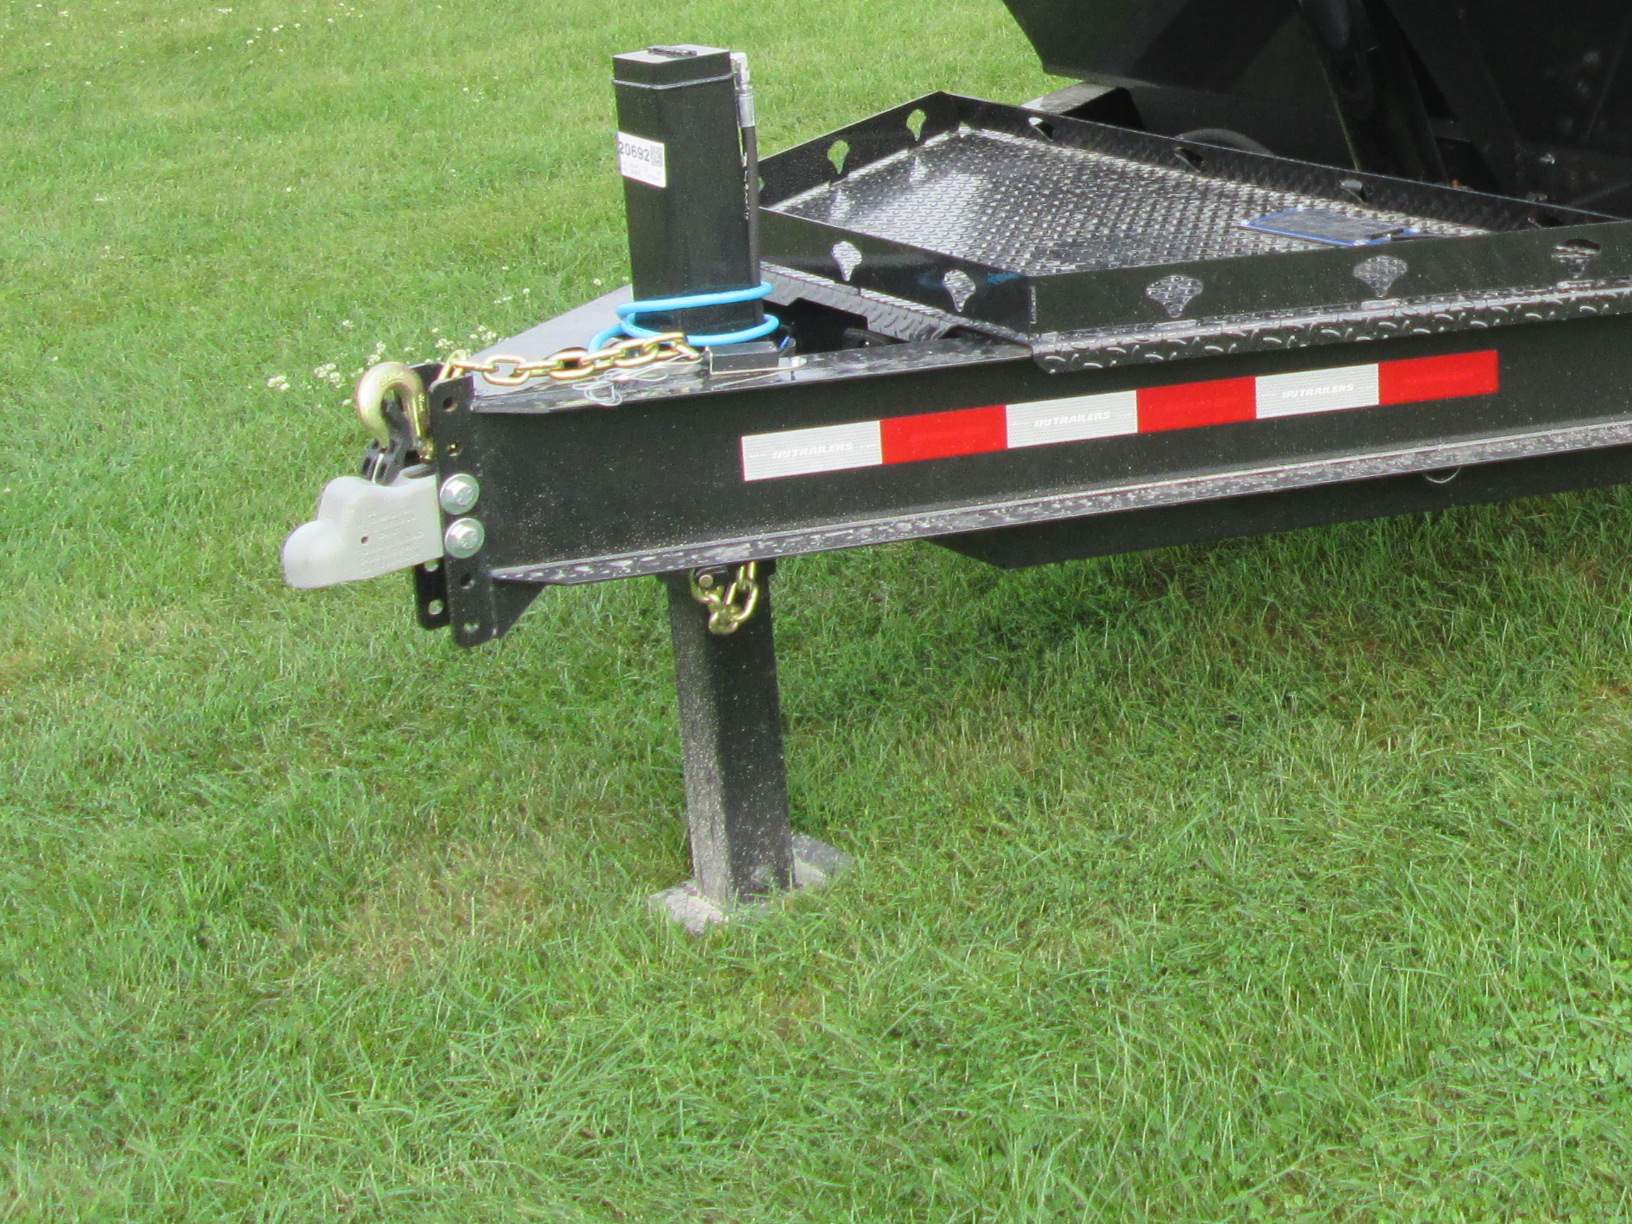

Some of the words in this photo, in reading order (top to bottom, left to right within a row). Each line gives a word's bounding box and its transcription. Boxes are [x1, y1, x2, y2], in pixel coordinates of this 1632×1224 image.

[619, 140, 650, 162] 20692
[1298, 383, 1354, 398] TRAILERS
[1050, 411, 1111, 426] TRAILERS
[789, 441, 853, 459] TRAILERS
